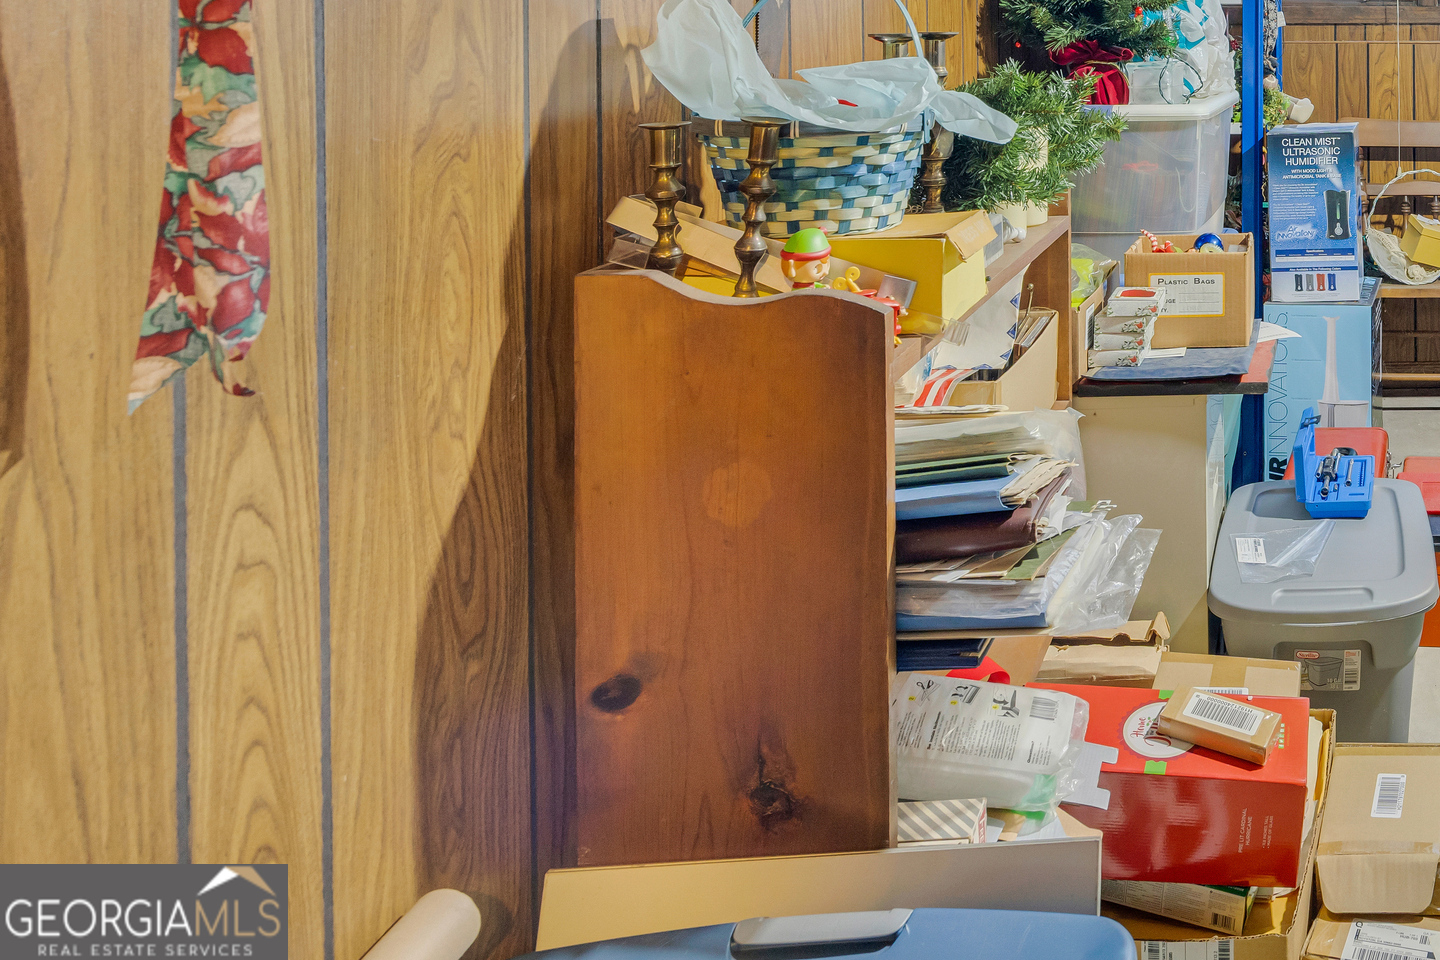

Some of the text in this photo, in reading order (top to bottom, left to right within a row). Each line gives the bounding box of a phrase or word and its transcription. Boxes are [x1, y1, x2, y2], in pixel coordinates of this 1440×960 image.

[1281, 138, 1312, 147] CLEAN
[1282, 147, 1341, 157] ULTRASONIC
[1285, 157, 1339, 166] HUMIDIFIER
[1240, 808, 1248, 835] CARDINAL
[1245, 816, 1253, 846] HURRICANE
